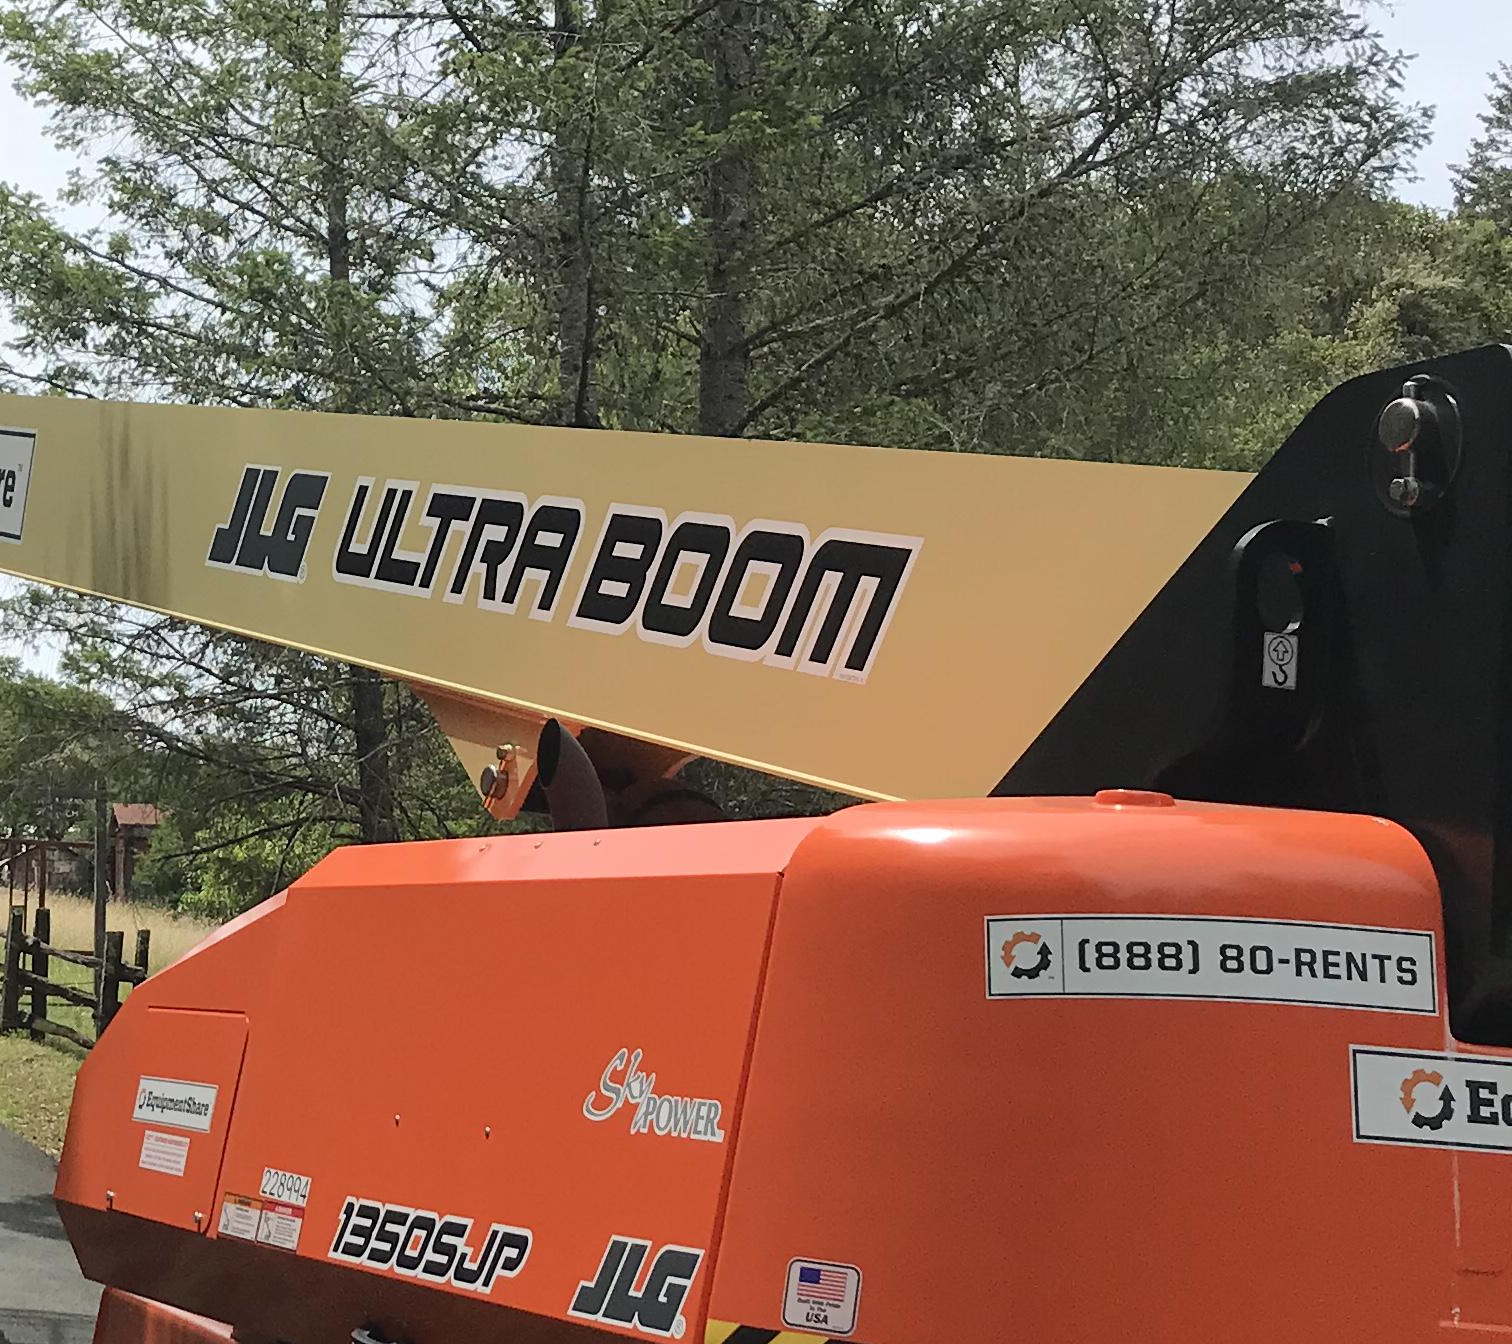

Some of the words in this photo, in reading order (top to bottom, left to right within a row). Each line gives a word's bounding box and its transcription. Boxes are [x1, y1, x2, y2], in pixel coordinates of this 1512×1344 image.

[208, 466, 330, 578] JLG
[334, 484, 583, 611] ULTRA
[576, 512, 913, 673] BOOM
[1078, 938, 1200, 975] (888)
[1218, 942, 1419, 987] 80-RENTS
[145, 1090, 210, 1117] EquipmentShare
[585, 1049, 655, 1131] Sky
[642, 1095, 720, 1137] POWER
[261, 1169, 310, 1204] 228994
[332, 1201, 530, 1288] 1350SJP
[571, 1239, 701, 1333] JLG
[805, 1312, 829, 1325] USA
